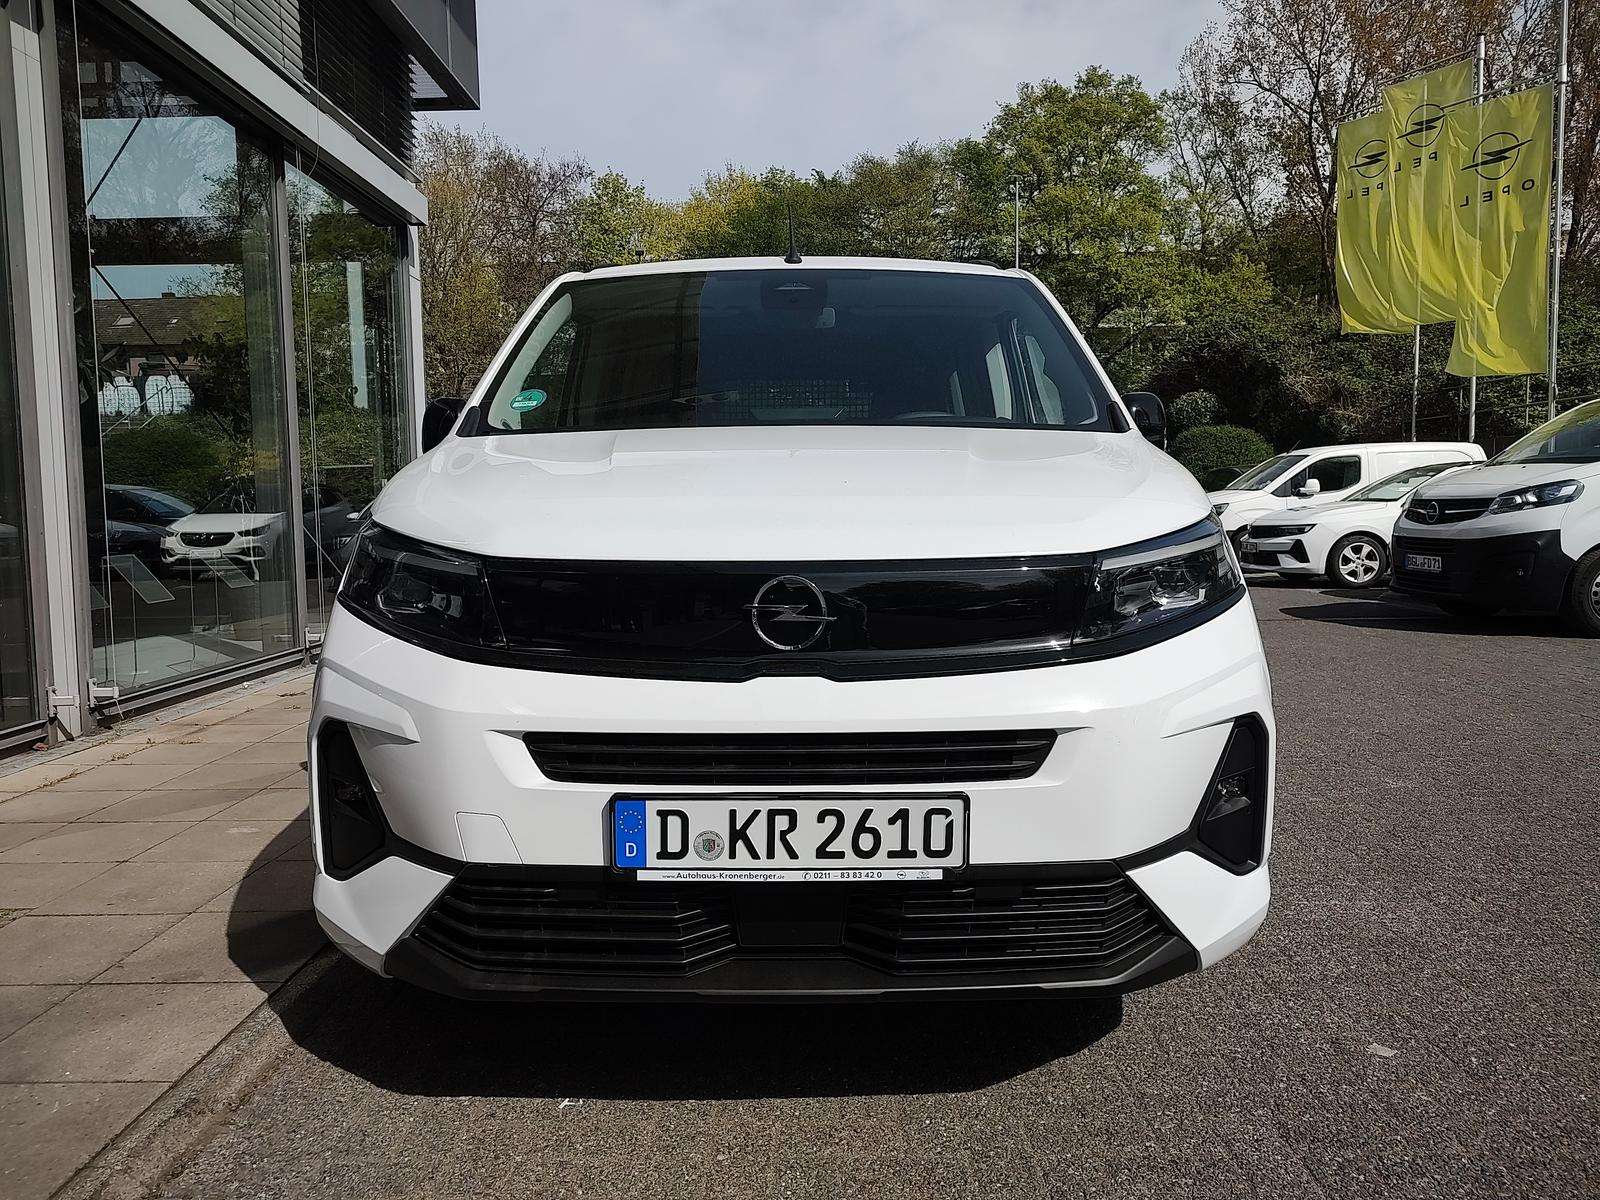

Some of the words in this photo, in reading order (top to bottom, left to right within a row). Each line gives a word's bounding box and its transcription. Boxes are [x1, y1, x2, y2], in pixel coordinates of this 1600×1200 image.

[655, 808, 690, 861] D
[728, 808, 800, 861] KR
[815, 807, 954, 860] 2610
[625, 842, 637, 857] D
[662, 872, 785, 882] www.Autohaus-Kronenberger.de
[813, 871, 831, 879] 0211
[840, 871, 850, 879] 83
[852, 871, 862, 879] 83
[864, 871, 875, 879] 42
